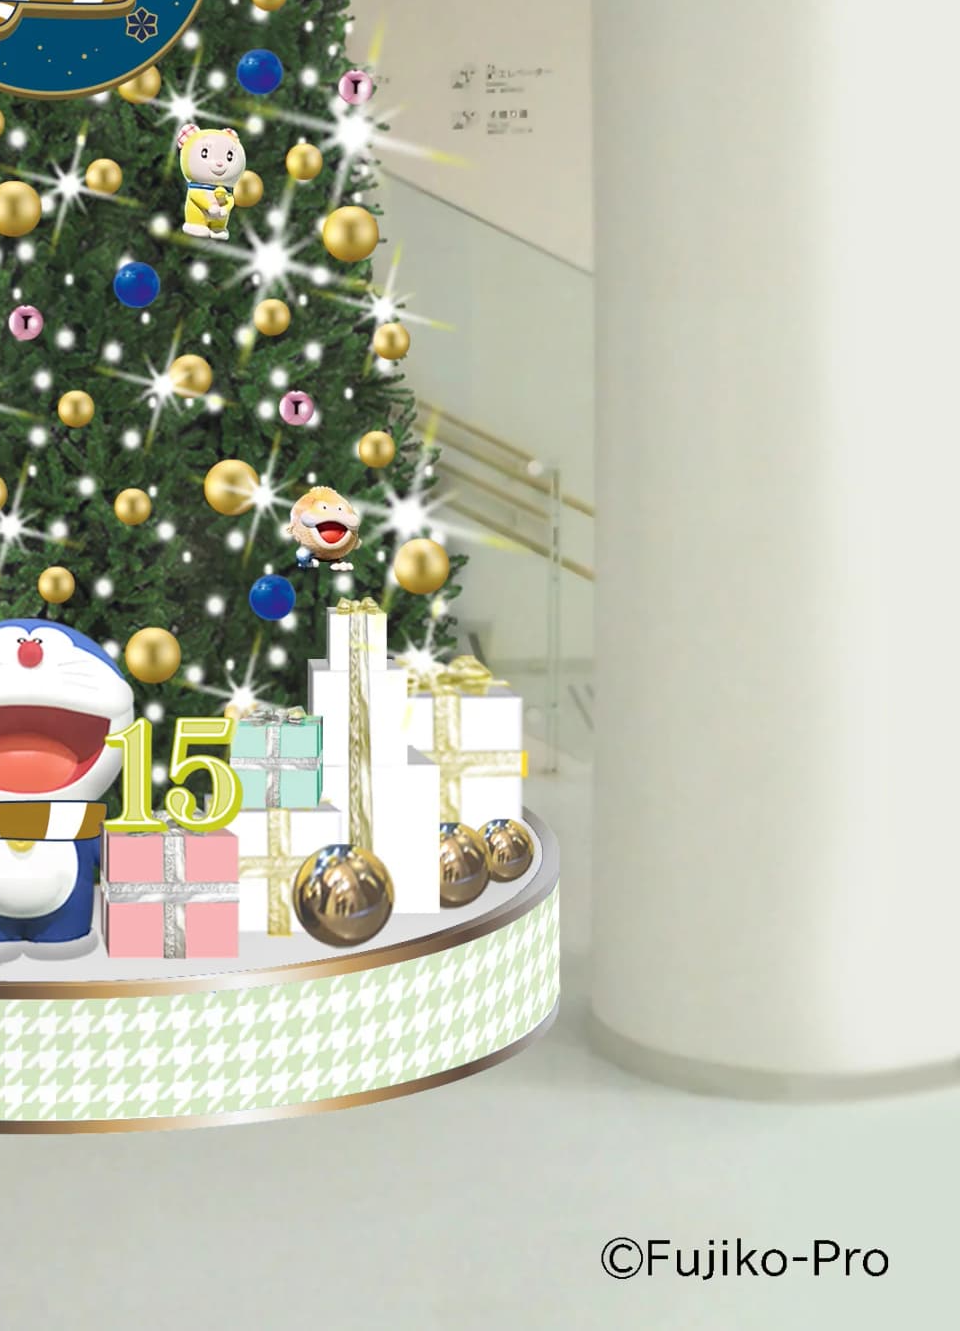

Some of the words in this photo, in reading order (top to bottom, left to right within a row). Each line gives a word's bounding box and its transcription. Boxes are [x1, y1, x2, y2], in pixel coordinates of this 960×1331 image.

[351, 80, 362, 94] T
[22, 315, 32, 330] T
[292, 401, 302, 415] T
[104, 718, 243, 832] 15
